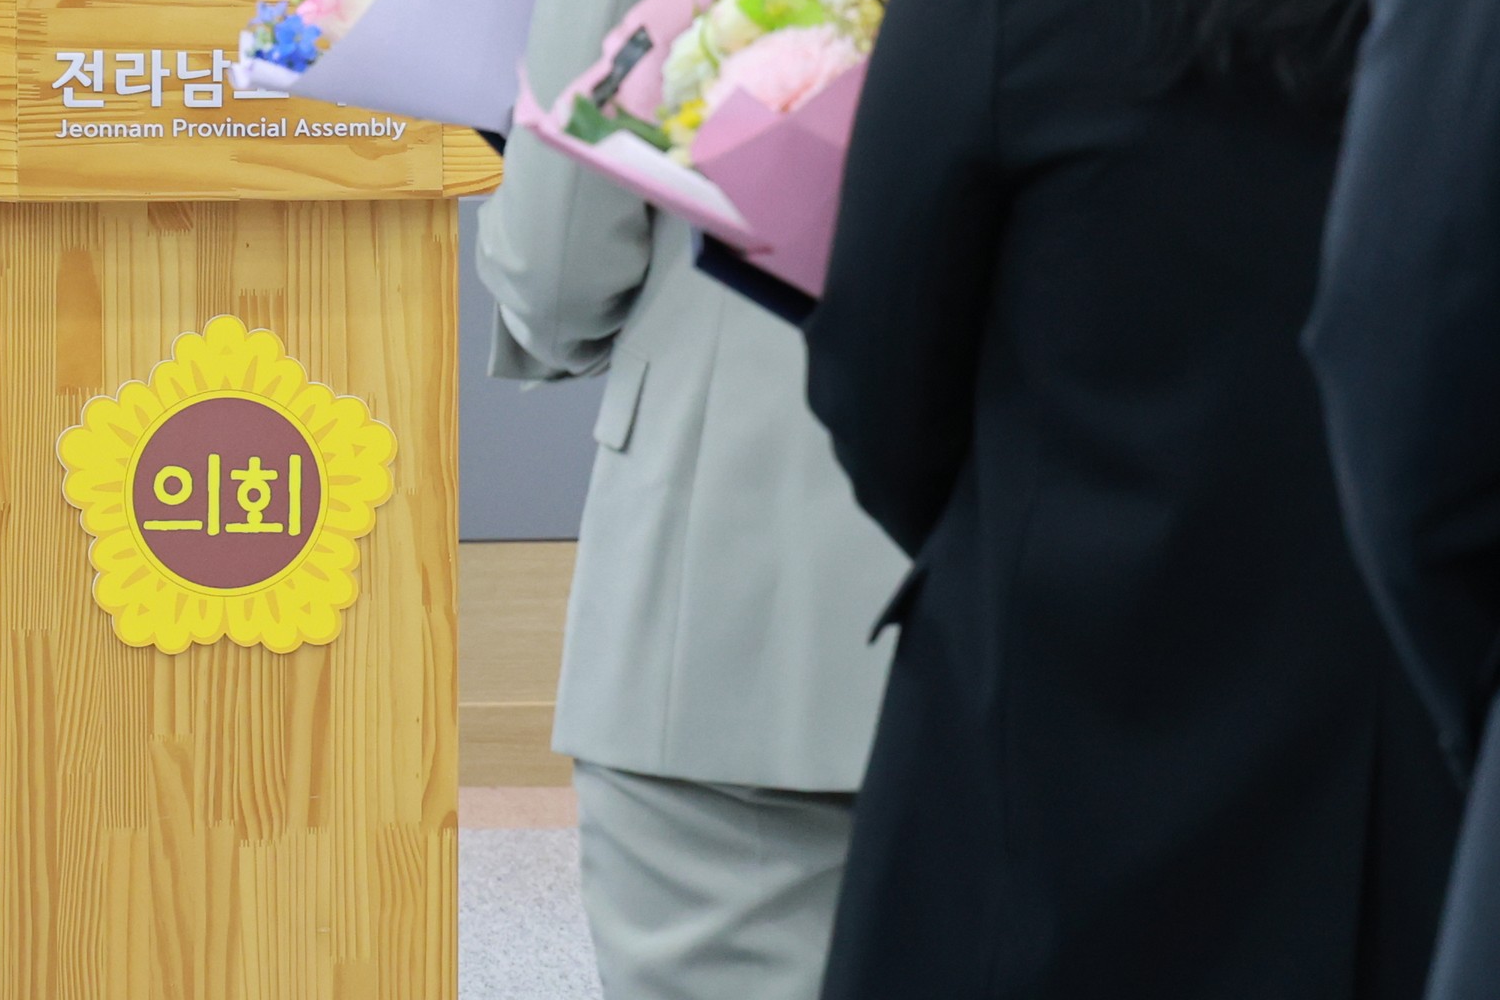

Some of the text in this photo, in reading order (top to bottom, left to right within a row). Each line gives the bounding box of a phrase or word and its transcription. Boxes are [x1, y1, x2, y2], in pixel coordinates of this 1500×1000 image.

[55, 117, 408, 141] Jeonnam Provincial Assembly
[142, 453, 303, 537] 의회
